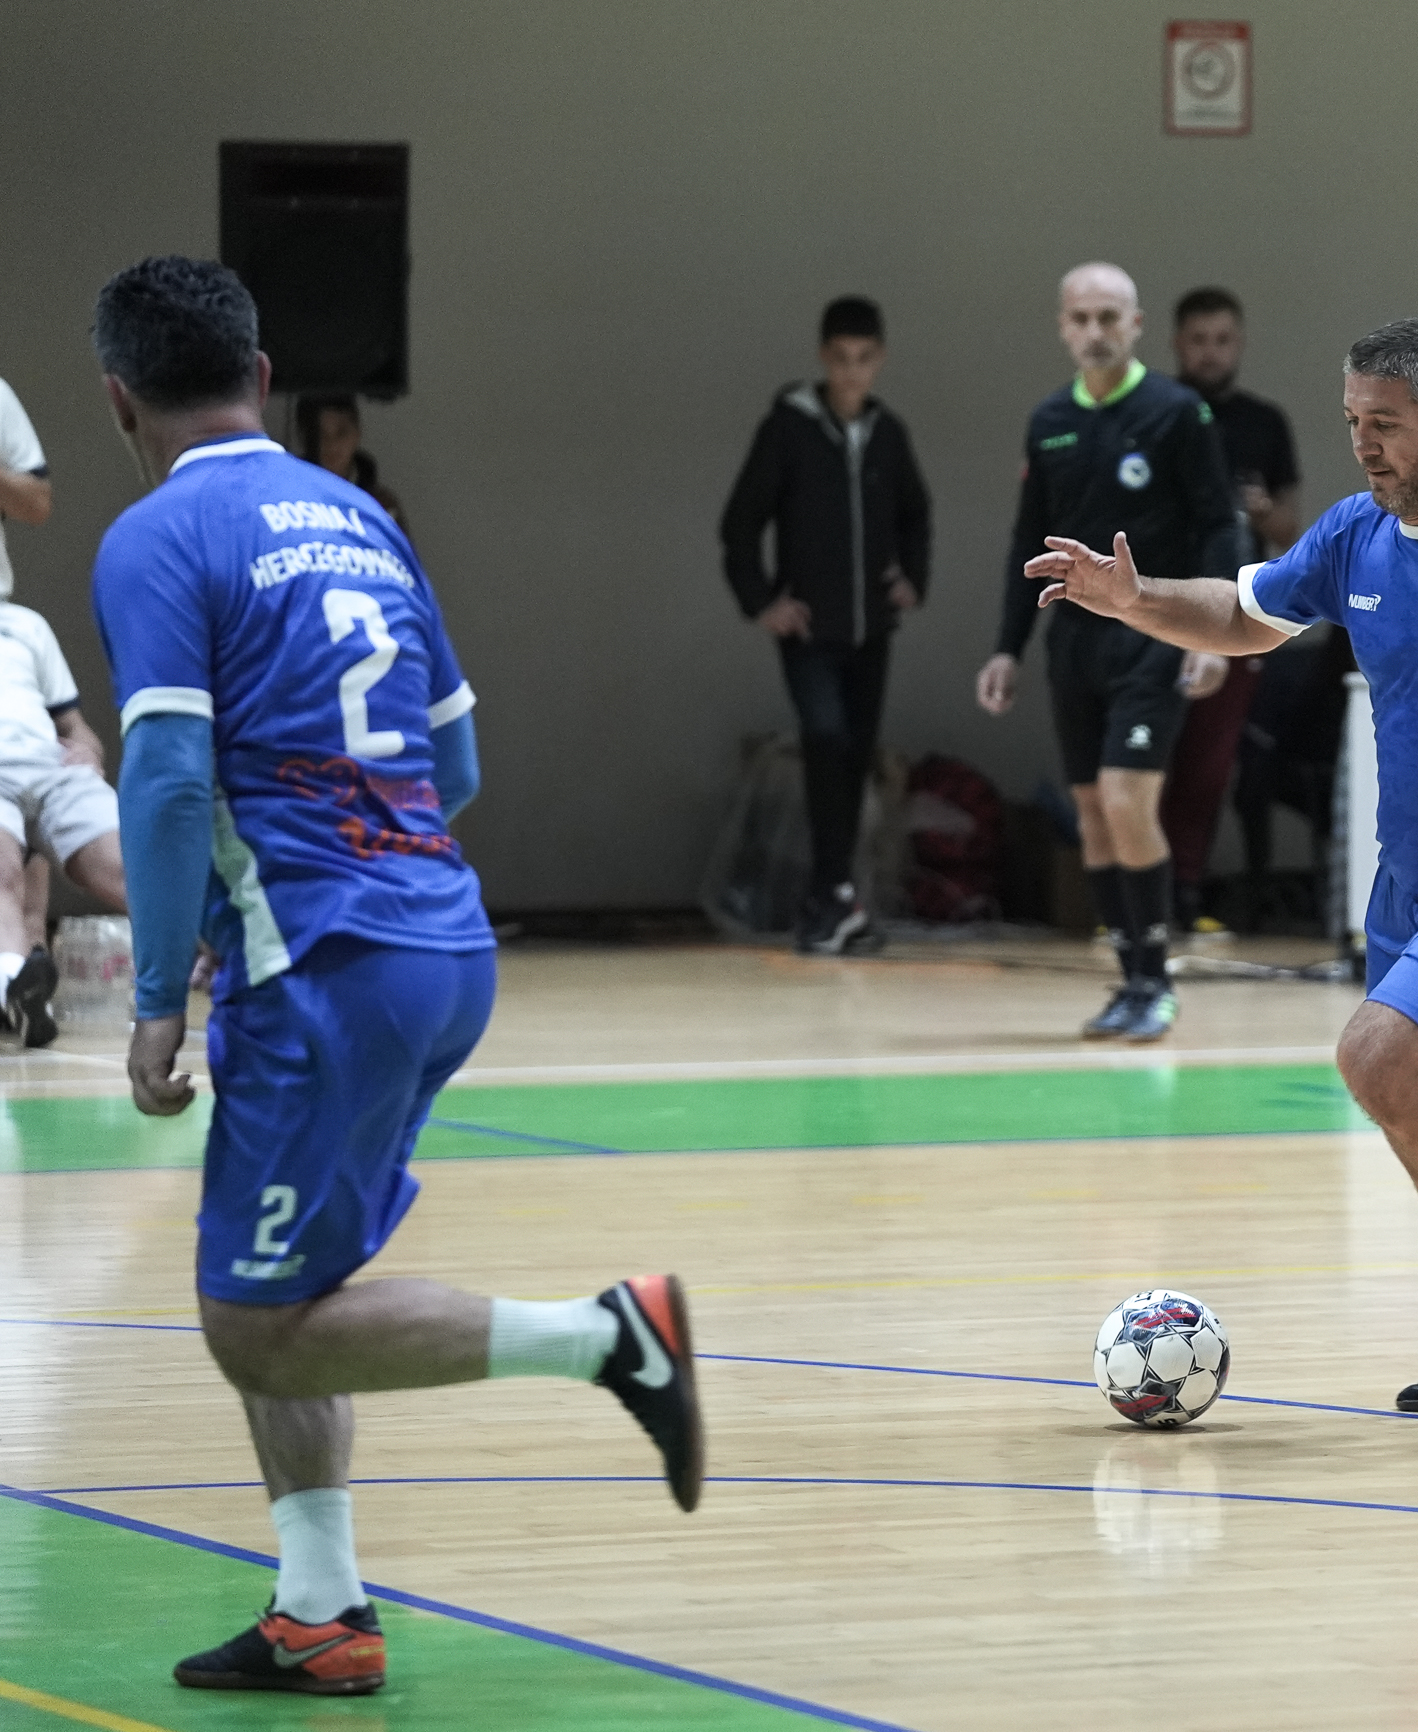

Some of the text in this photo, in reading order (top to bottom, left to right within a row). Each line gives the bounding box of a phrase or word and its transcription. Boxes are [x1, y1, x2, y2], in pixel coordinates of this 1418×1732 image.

[260, 500, 355, 534] BOSNA
[321, 587, 406, 758] 2
[253, 1184, 298, 1256] 2
